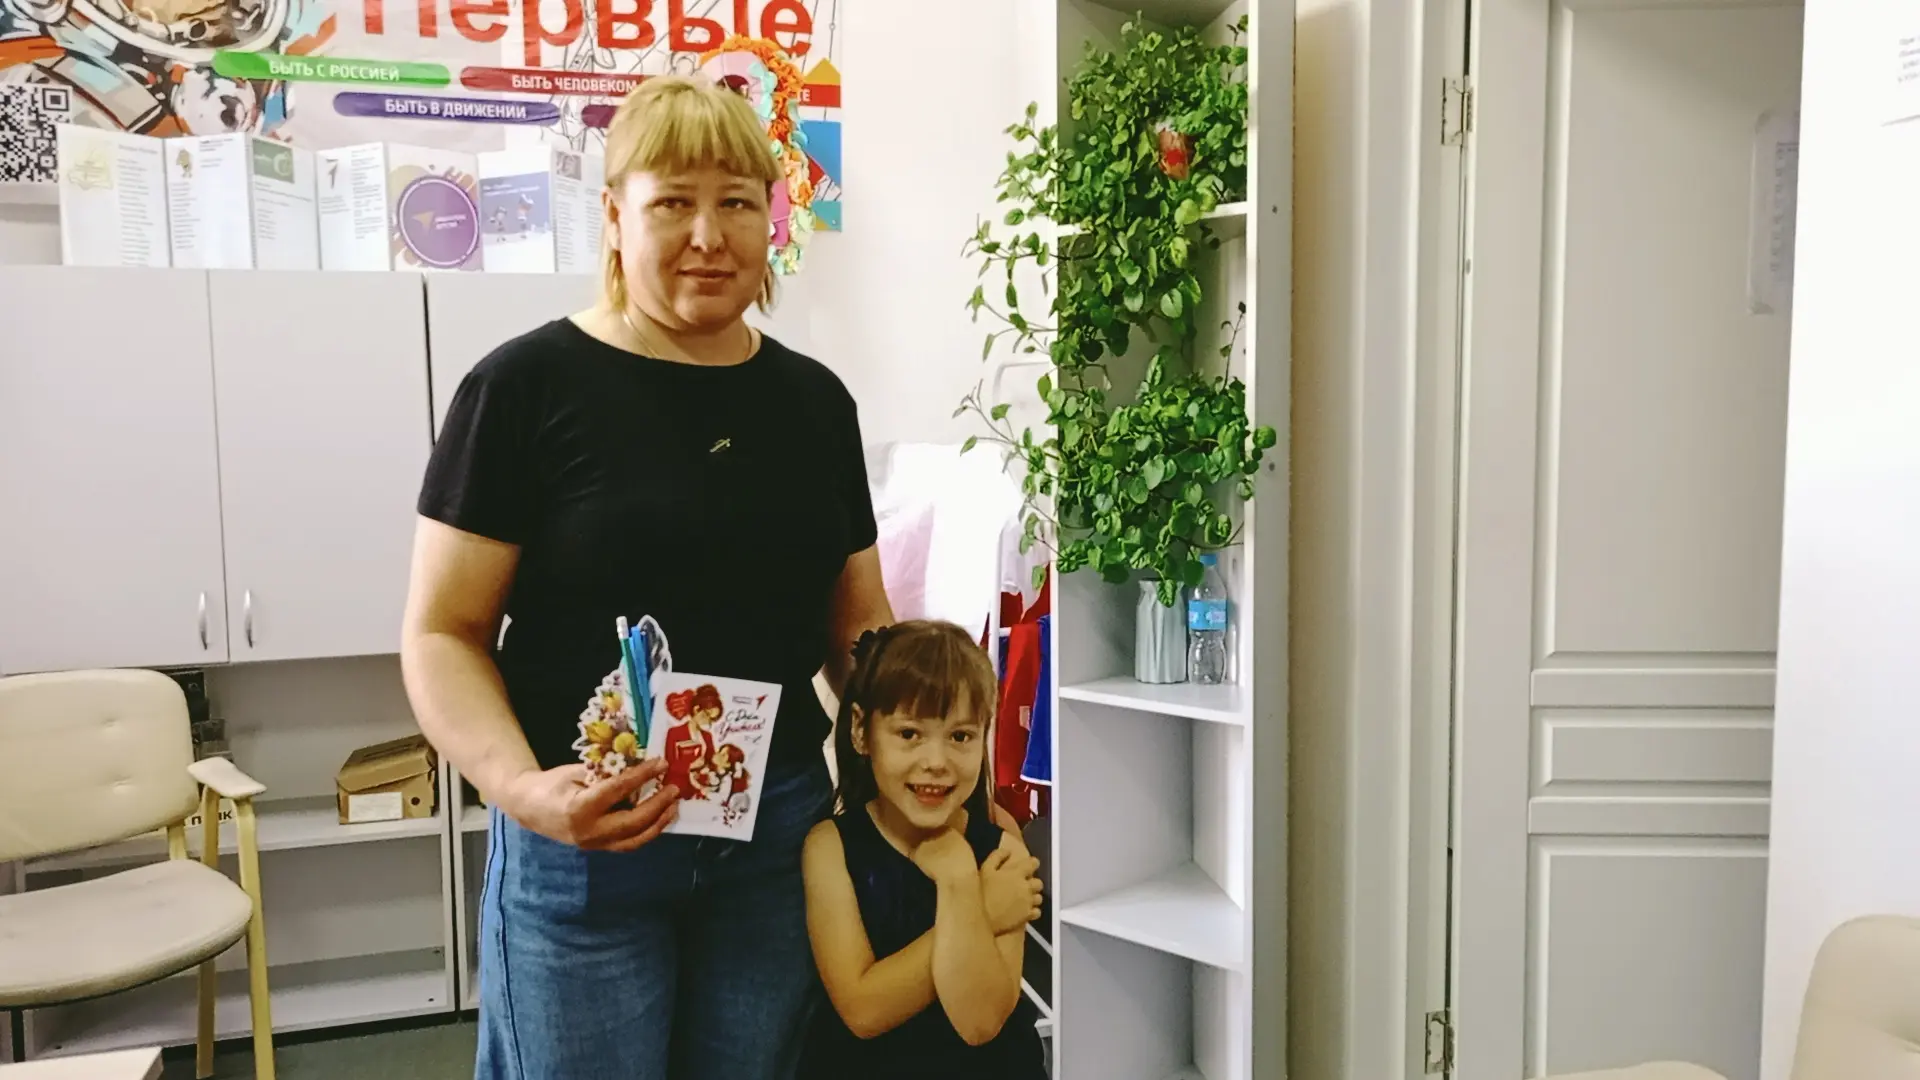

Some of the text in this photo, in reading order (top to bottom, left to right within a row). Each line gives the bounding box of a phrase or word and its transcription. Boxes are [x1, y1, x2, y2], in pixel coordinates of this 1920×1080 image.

[269, 60, 400, 82] БЫТЬ С РОССИЕЙ
[511, 74, 637, 93] БЫТЬ ЧЕЛОВЕКОМ
[384, 99, 527, 119] БЫТЬ В ДВИЖЕНИИ
